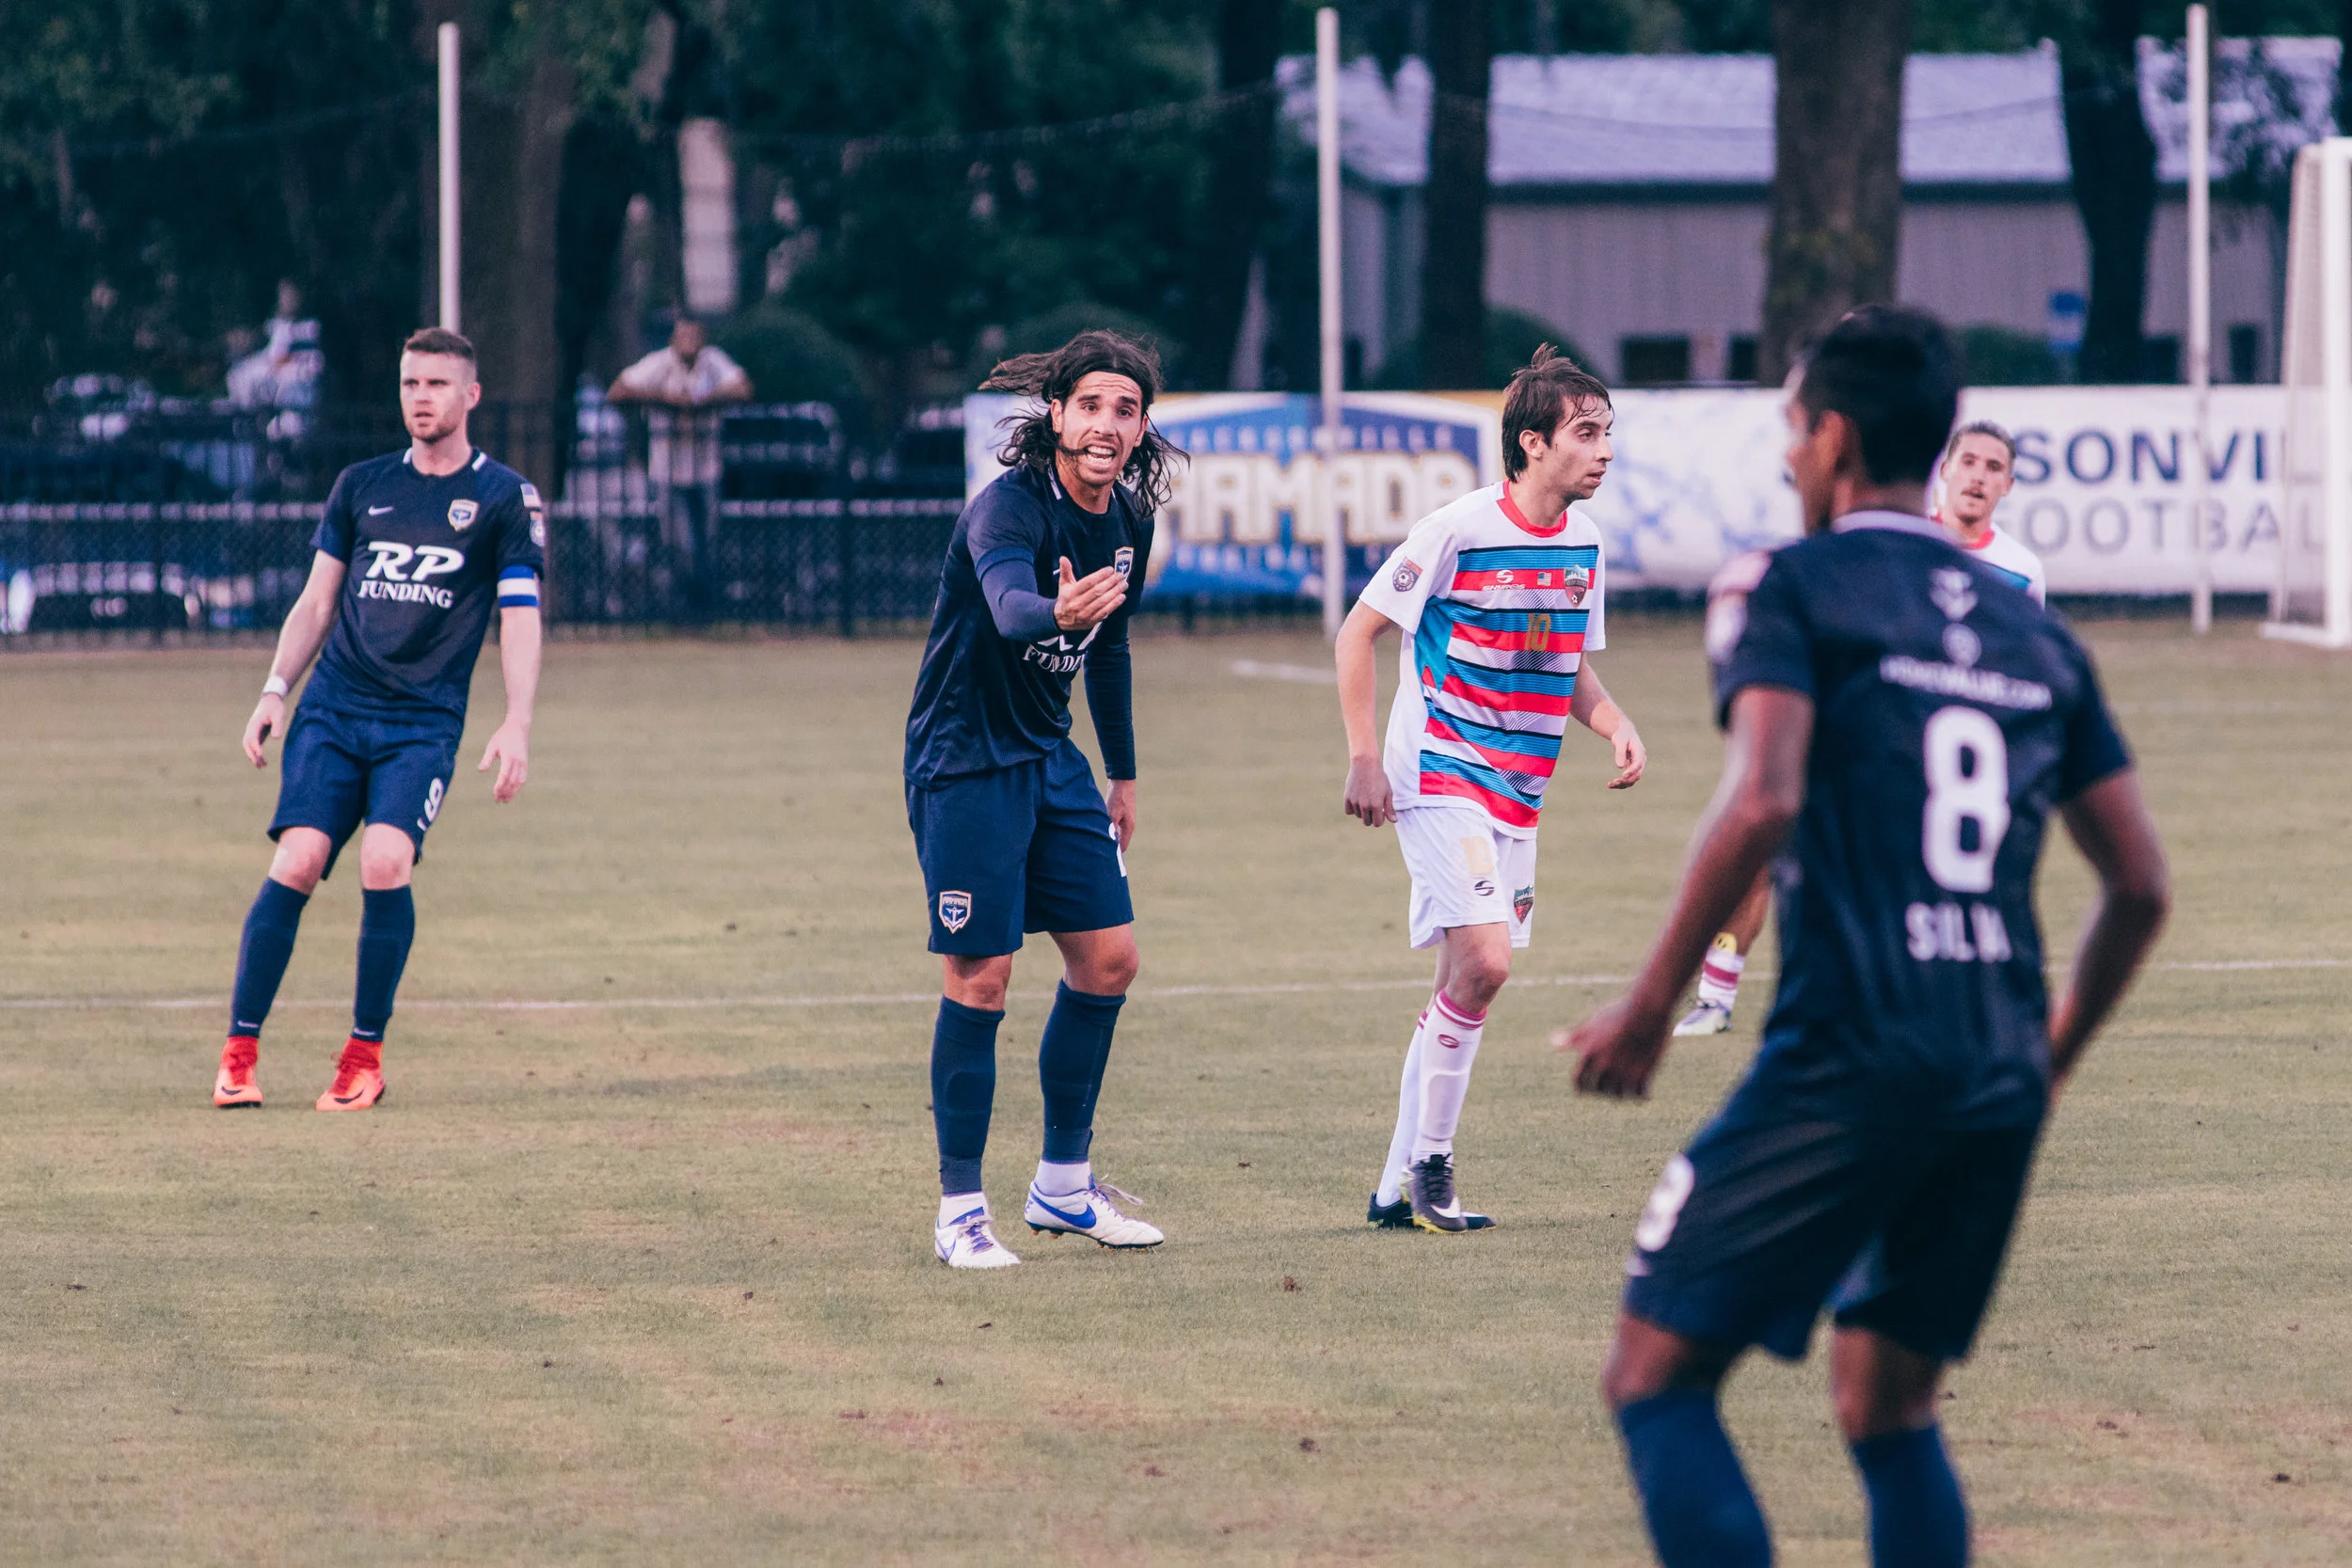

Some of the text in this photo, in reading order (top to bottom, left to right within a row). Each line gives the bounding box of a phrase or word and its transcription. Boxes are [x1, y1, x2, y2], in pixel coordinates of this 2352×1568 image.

[365, 541, 466, 582] RP
[358, 579, 455, 610] FUNDING
[1524, 612, 1551, 652] 10
[1922, 705, 2011, 895] 8
[1460, 836, 1494, 875] 10
